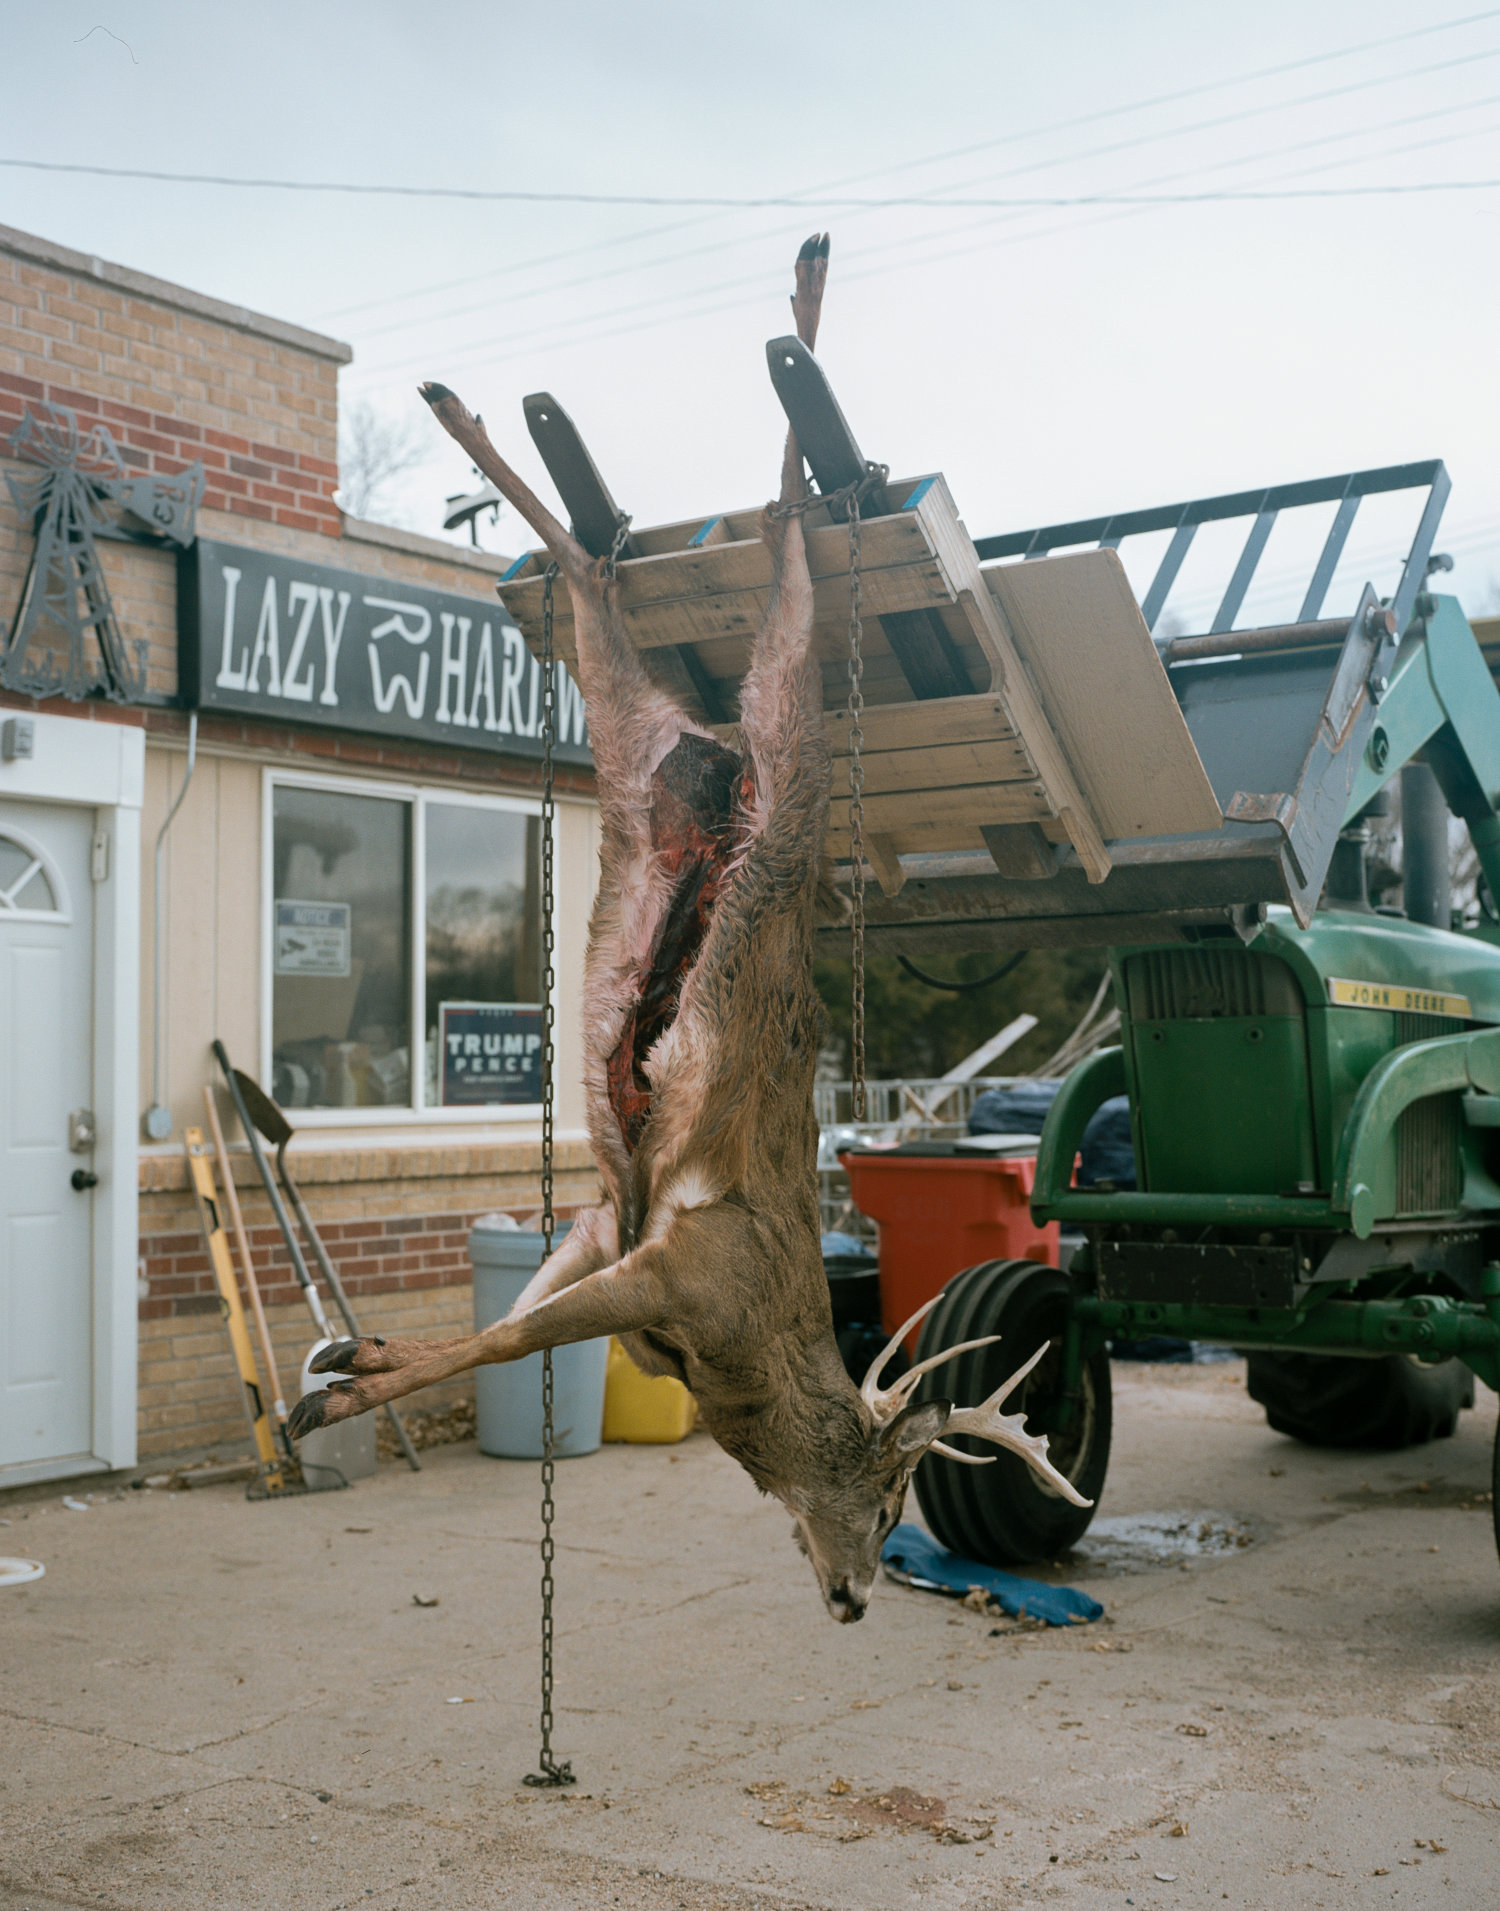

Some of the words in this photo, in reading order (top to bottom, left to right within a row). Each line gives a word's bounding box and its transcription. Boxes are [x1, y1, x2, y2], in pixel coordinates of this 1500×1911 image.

[216, 566, 351, 706] LAZY
[1351, 986, 1390, 1006] JOHN
[1405, 992, 1446, 1013] DEERE
[447, 1033, 541, 1056] TRUMP
[455, 1056, 533, 1073] PENCE
